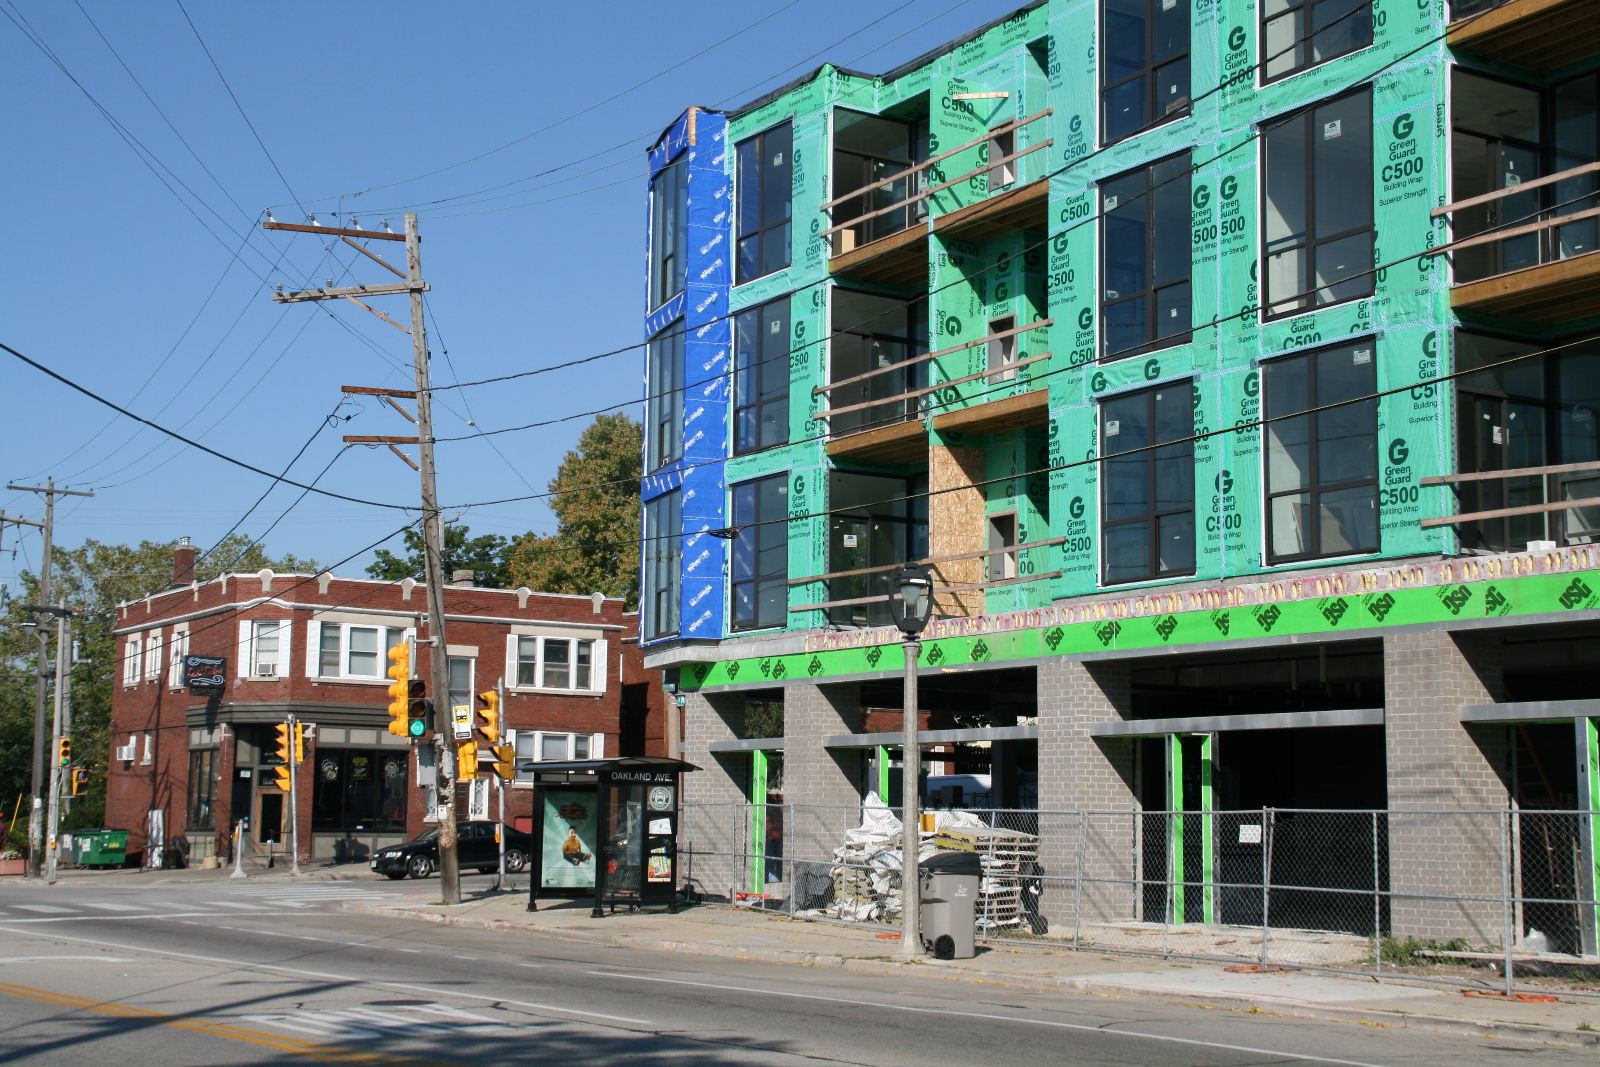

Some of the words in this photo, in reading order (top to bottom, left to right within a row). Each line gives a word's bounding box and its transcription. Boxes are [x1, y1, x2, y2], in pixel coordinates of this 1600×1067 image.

[1228, 26, 1246, 51] G
[1225, 49, 1247, 62] Green
[1344, 51, 1369, 63] Superior
[1225, 58, 1247, 71] Guard
[1220, 65, 1254, 90] C500
[948, 81, 968, 92] Green
[1377, 81, 1400, 94] Strength
[942, 97, 974, 115] C500
[944, 110, 961, 120] Building
[1070, 115, 1081, 132] G
[940, 120, 958, 129] Superior
[959, 124, 977, 133] Strength
[1393, 113, 1414, 140] G
[1064, 143, 1086, 160] C500
[1389, 138, 1415, 152] Green
[1389, 146, 1416, 161] Guard
[794, 149, 801, 163] G
[1382, 157, 1423, 183] C500
[1221, 176, 1237, 200] G
[1384, 181, 1406, 192] Building
[1408, 176, 1423, 186] Wrap
[1066, 192, 1085, 206] Guard
[1193, 185, 1210, 209] G
[1379, 194, 1402, 207] Superior
[1404, 188, 1427, 199] Strength
[1060, 202, 1090, 223] C500
[810, 219, 819, 233] G
[1192, 225, 1217, 244] 500
[1054, 232, 1069, 254] G
[1229, 244, 1248, 254] Strength
[997, 252, 1011, 273] G
[1051, 253, 1070, 264] Green
[1051, 258, 1070, 272] Guard
[995, 281, 1009, 302] G
[1061, 295, 1077, 305] Strength
[992, 301, 1009, 311] Green
[944, 316, 962, 337] G
[1078, 307, 1093, 331] G
[1290, 321, 1315, 333] Guard
[795, 321, 805, 339] G
[1076, 329, 1094, 340] Green
[793, 339, 806, 347] Green
[1076, 337, 1094, 348] Guard
[1283, 332, 1322, 350] C500
[790, 351, 808, 369] C500
[1419, 360, 1435, 369] Gre
[1144, 359, 1160, 380] G
[1419, 369, 1436, 379] Gua
[1091, 372, 1107, 392] G
[1241, 399, 1259, 407] Gree
[1241, 407, 1259, 416] Guar
[1409, 415, 1433, 423] Superior
[1237, 435, 1256, 443] Building
[1234, 448, 1253, 457] Superior
[1389, 438, 1409, 465] G
[1385, 466, 1411, 476] Green
[1385, 473, 1411, 486] Guard
[794, 475, 805, 494] G
[1215, 470, 1233, 494] G
[1380, 486, 1419, 506] C500
[789, 508, 809, 523] C500
[1070, 496, 1084, 519] G
[1404, 505, 1418, 513] Wrap
[1067, 519, 1086, 528] Green
[1067, 526, 1086, 536] Guard
[1062, 536, 1091, 553] C500
[1225, 543, 1245, 552] Strength
[1063, 553, 1079, 562] Building
[1442, 585, 1472, 615] USG
[1559, 577, 1593, 610] USG
[1322, 597, 1349, 626] USG
[1368, 593, 1396, 622] USG
[1256, 605, 1281, 632] USG
[1097, 621, 1122, 647] USG
[1156, 615, 1178, 641] USG
[1045, 627, 1064, 651] USG
[867, 646, 882, 668] USG
[926, 643, 944, 665] USG
[971, 639, 989, 662] USG
[727, 660, 740, 680] USG
[771, 659, 785, 680] USG
[807, 655, 823, 676] USG
[611, 772, 651, 781] OAKLAND
[654, 773, 673, 782] AVE.
